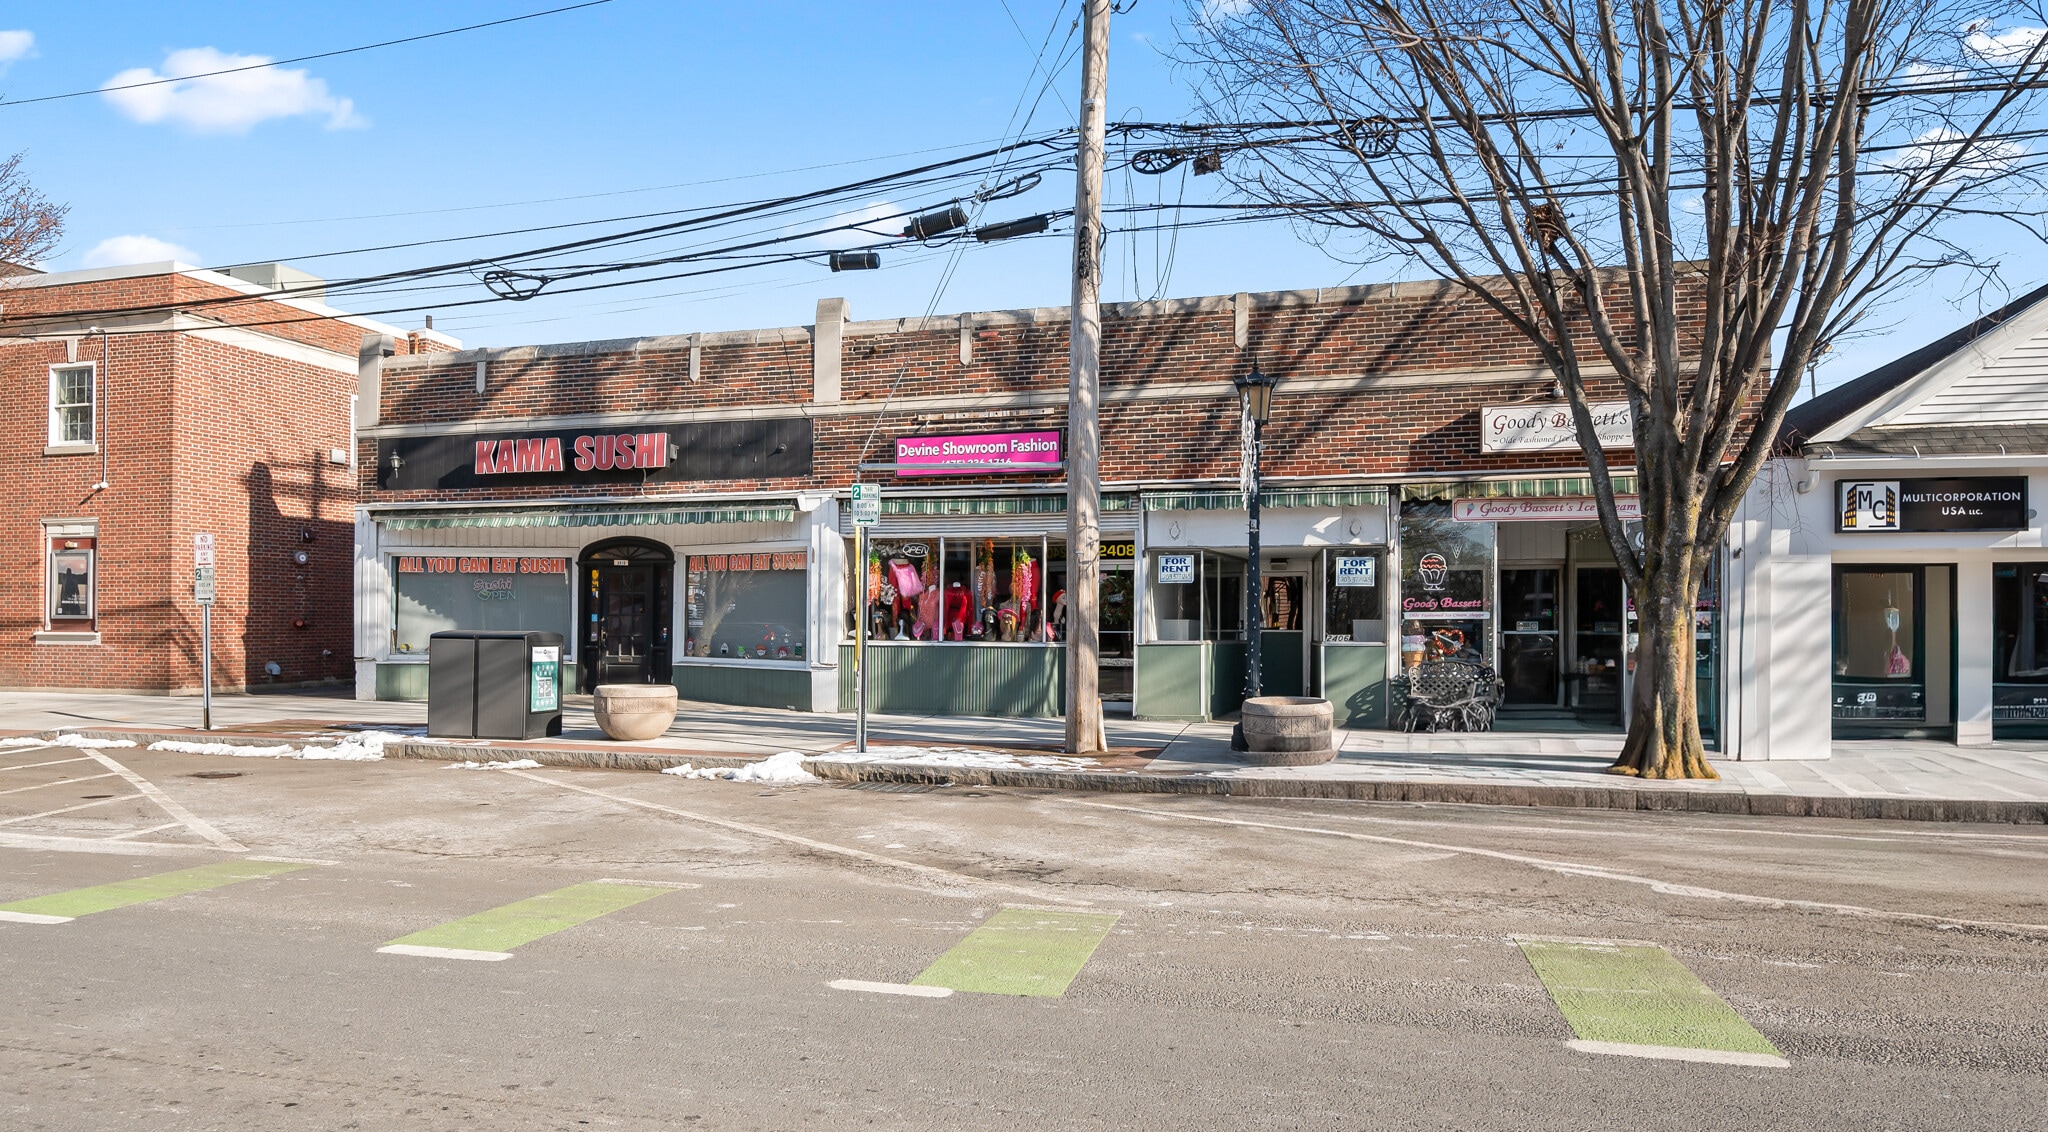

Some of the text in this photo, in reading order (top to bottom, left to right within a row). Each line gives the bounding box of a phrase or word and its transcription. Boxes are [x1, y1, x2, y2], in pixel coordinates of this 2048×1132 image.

[1492, 410, 1629, 435] Goody Baett's
[1499, 436, 1516, 444] Olde
[1518, 434, 1556, 444] Fashioned
[1598, 433, 1625, 445] Shoppe
[475, 432, 667, 474] KAMA SUSHI
[898, 437, 1058, 457] Devine Showroom Fashion
[853, 487, 860, 498] 2
[1902, 491, 2021, 503] MULTICORPORATION
[1480, 501, 1637, 516] Goody Bassett's Ice eam
[1941, 506, 1966, 516] USA
[200, 535, 208, 543] NO
[903, 545, 929, 555] OPEN
[1100, 544, 1135, 557] 2408
[398, 557, 567, 574] ALL YOU CAN EAT SUSHI
[689, 552, 807, 572] ALL YOU CAN EAT SUSHI
[1165, 557, 1187, 565] FOR
[1343, 559, 1367, 567] FOR
[196, 569, 201, 580] 2
[1339, 567, 1371, 575] RENT
[473, 577, 513, 591] Sushi
[477, 589, 518, 601] OPEN
[1403, 596, 1490, 611] Goody Bassett's
